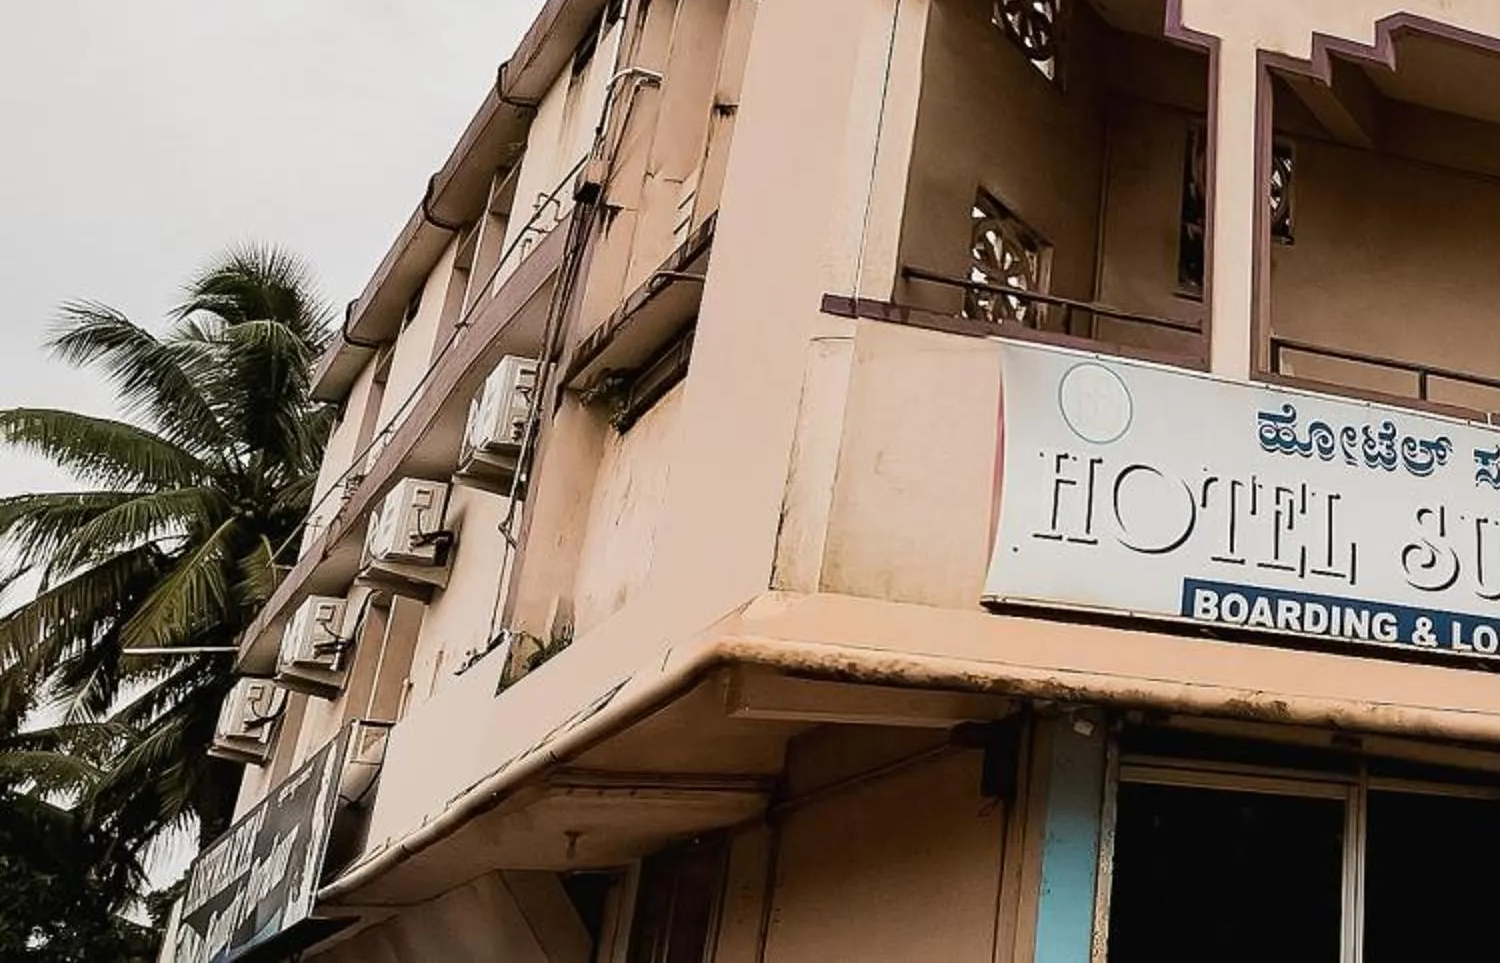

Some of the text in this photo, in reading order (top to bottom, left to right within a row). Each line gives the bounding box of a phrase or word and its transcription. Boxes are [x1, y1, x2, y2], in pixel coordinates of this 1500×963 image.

[1257, 404, 1453, 477] ಹೋಟೆಲ್
[1032, 450, 1356, 585] HOTEL
[1193, 588, 1398, 642] BOARDING
[1411, 616, 1438, 648] &
